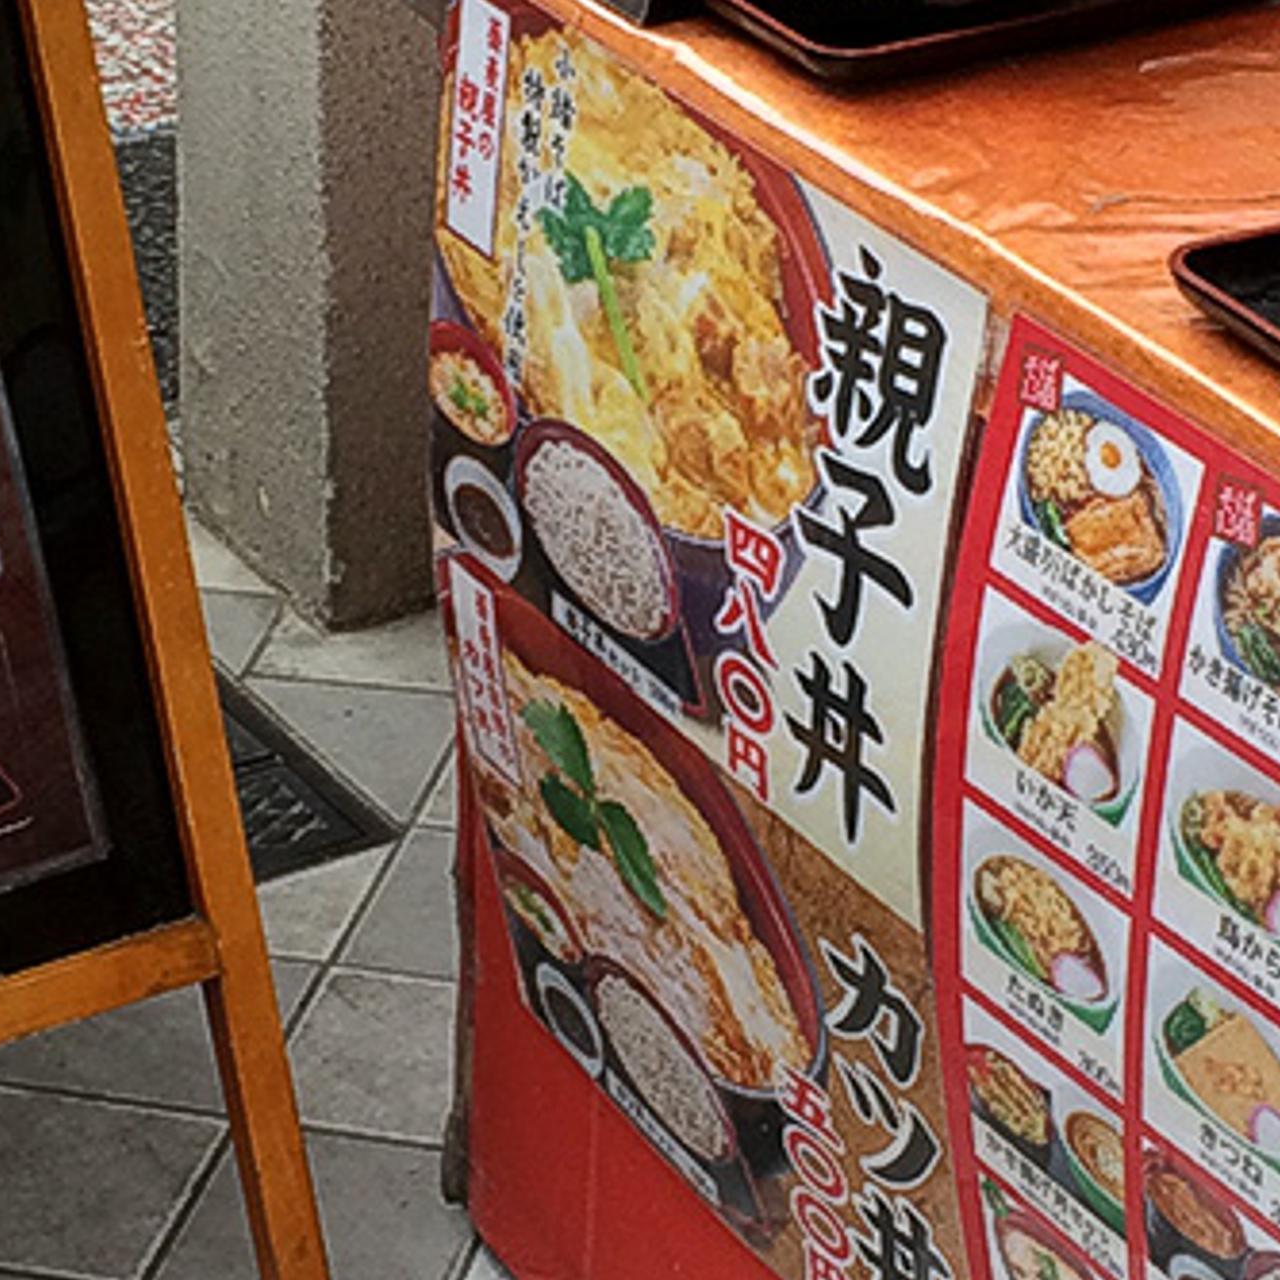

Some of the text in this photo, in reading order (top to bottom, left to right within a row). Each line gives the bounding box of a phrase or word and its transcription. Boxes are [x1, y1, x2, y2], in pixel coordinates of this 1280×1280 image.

[718, 512, 782, 802] 四八〇円
[785, 245, 949, 843] 親子丼
